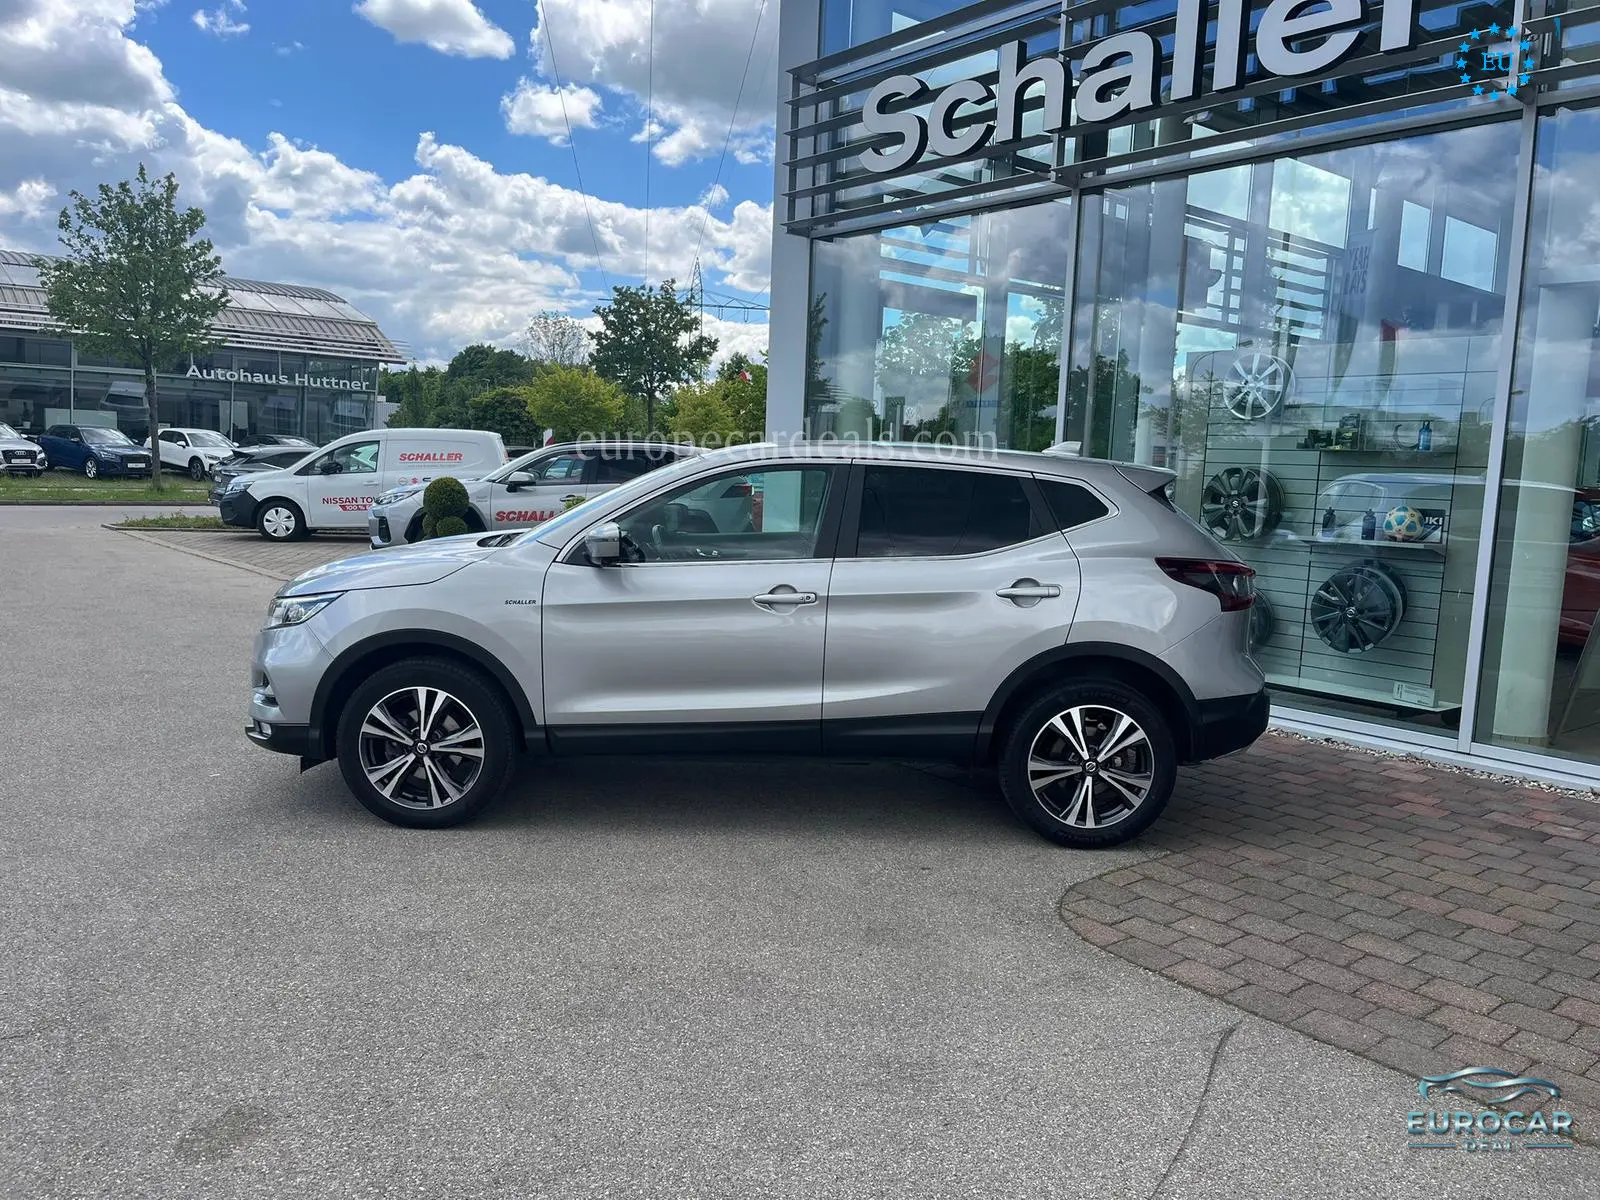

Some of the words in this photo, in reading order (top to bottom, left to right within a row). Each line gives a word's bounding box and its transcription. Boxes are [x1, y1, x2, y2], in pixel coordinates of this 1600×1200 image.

[186, 365, 289, 385] Autohaus
[294, 373, 370, 391] Huttner
[399, 452, 463, 462] SCHALLER
[322, 496, 358, 505] NISSAN
